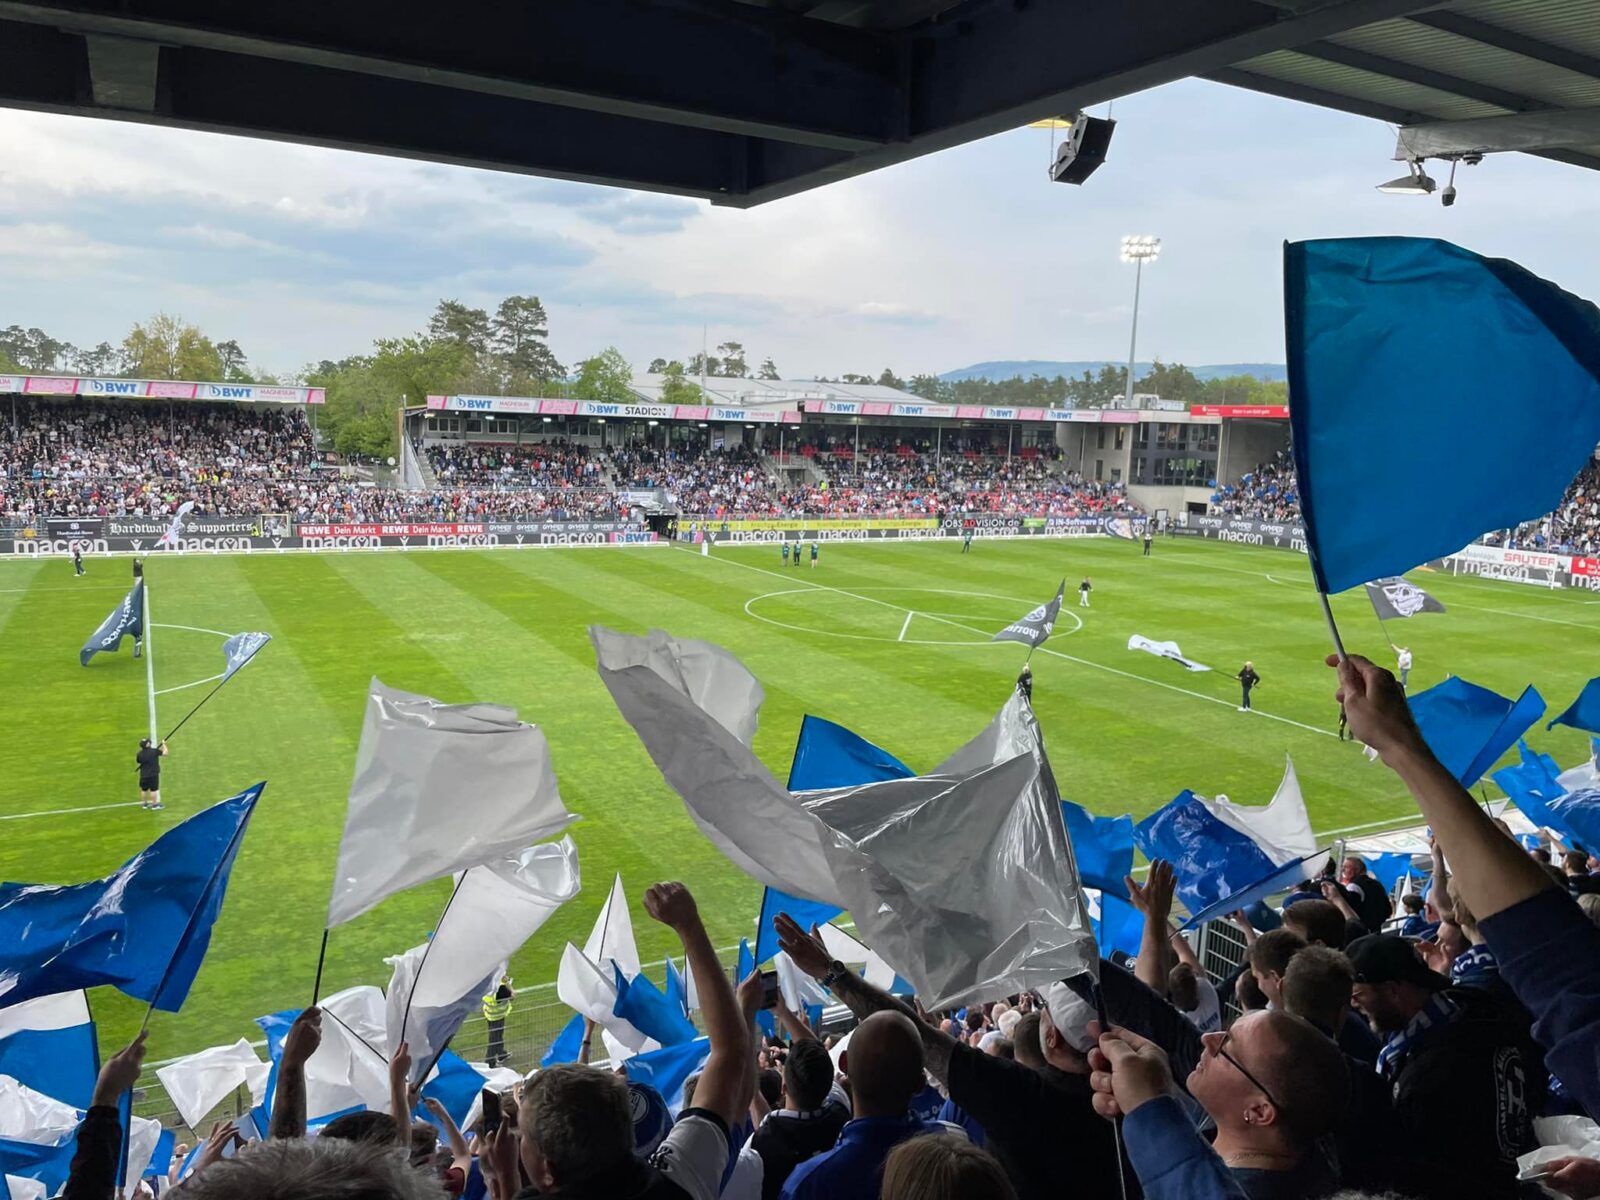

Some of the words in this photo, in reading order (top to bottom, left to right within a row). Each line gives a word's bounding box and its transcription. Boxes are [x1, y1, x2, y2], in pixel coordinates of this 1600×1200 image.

[105, 383, 137, 393] BWT
[222, 388, 251, 397] BWT
[467, 400, 492, 409] BWT
[837, 404, 855, 412] BWT
[597, 406, 618, 414] BWT
[625, 406, 666, 416] STADION
[725, 411, 745, 419] BWT
[109, 523, 172, 535] Hardtwal
[187, 522, 252, 534] Supporters
[301, 526, 330, 535] REWE
[334, 526, 350, 534] Dein
[353, 526, 376, 534] Markt
[382, 525, 409, 534] REWE
[413, 525, 429, 533] Dein
[430, 525, 452, 533] Markt
[457, 524, 483, 533] REWE
[899, 528, 946, 538] macron
[974, 527, 1019, 537] macron
[1045, 526, 1087, 535] macron
[427, 534, 499, 546] macron
[540, 532, 606, 544] macron
[625, 532, 653, 543] BWT
[730, 530, 785, 541] macron
[818, 529, 869, 540] macron
[1218, 528, 1263, 545] macron
[302, 535, 381, 548] macron
[1463, 561, 1529, 579] macron
